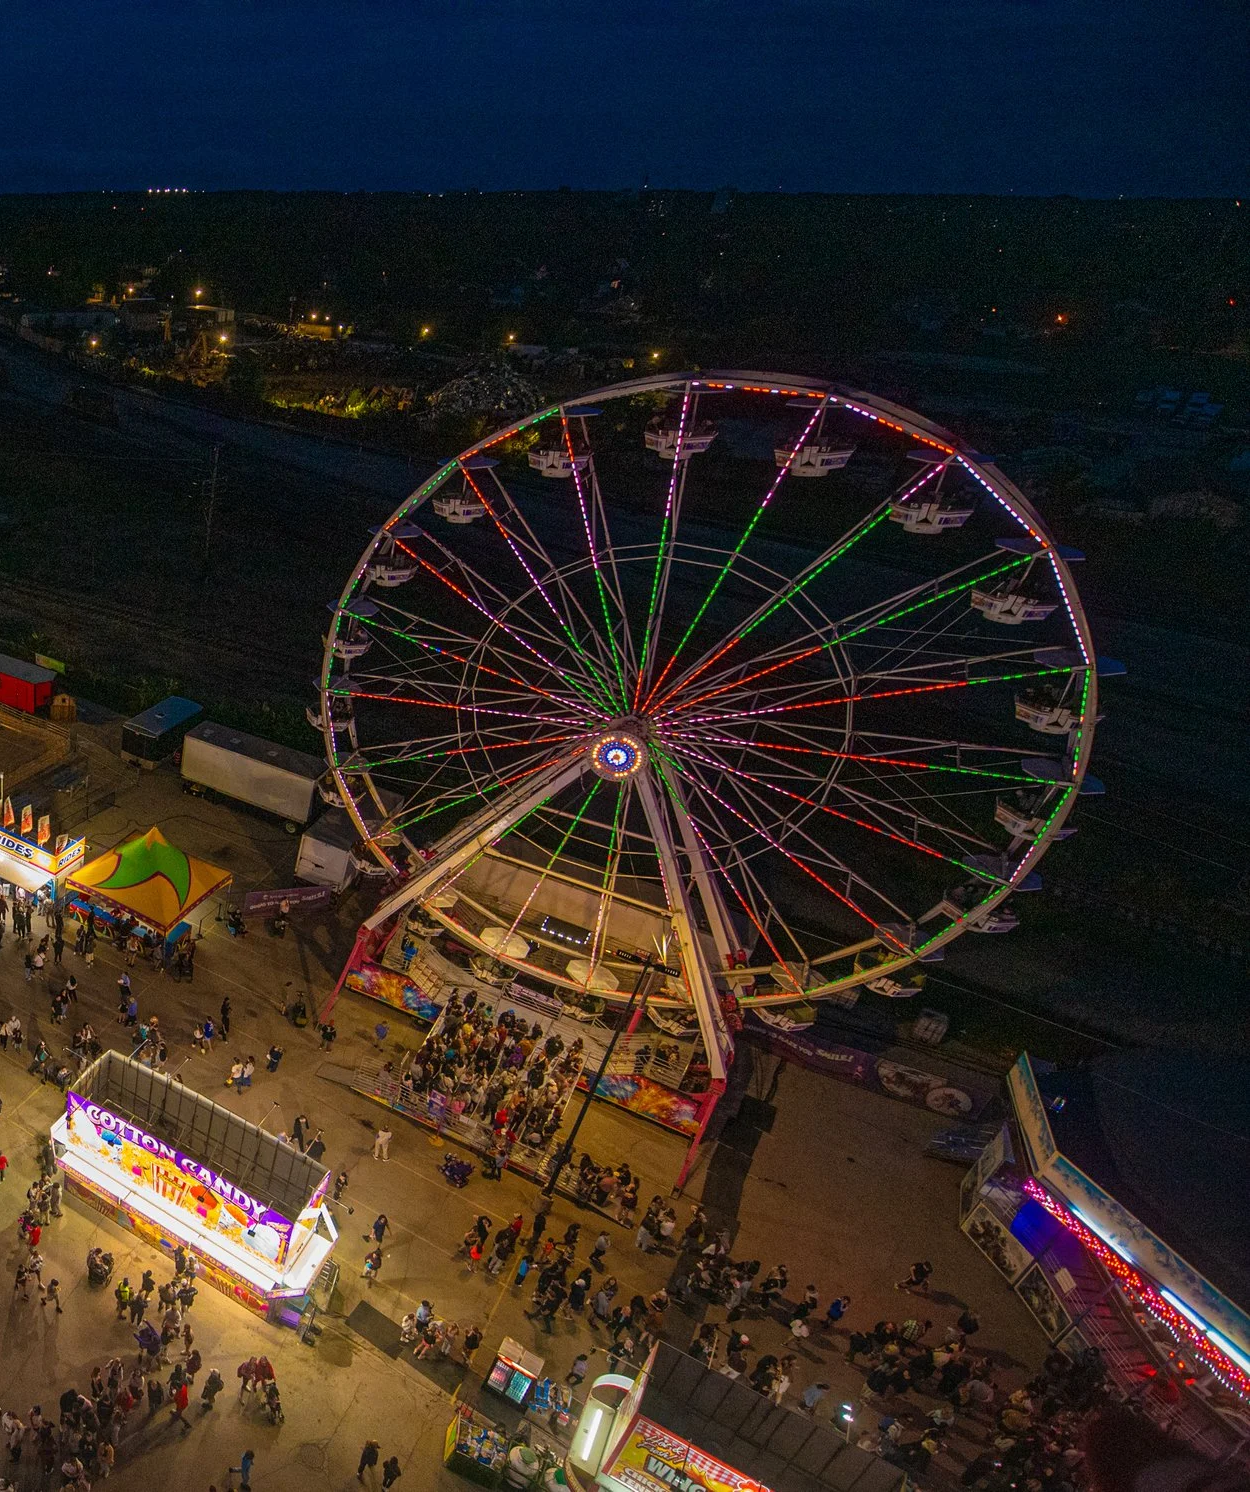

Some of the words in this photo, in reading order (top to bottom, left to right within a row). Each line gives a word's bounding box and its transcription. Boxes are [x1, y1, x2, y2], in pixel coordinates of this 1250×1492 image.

[57, 846, 83, 869] RIDES
[86, 1104, 178, 1163] COTTON
[181, 1158, 269, 1221] CANDY
